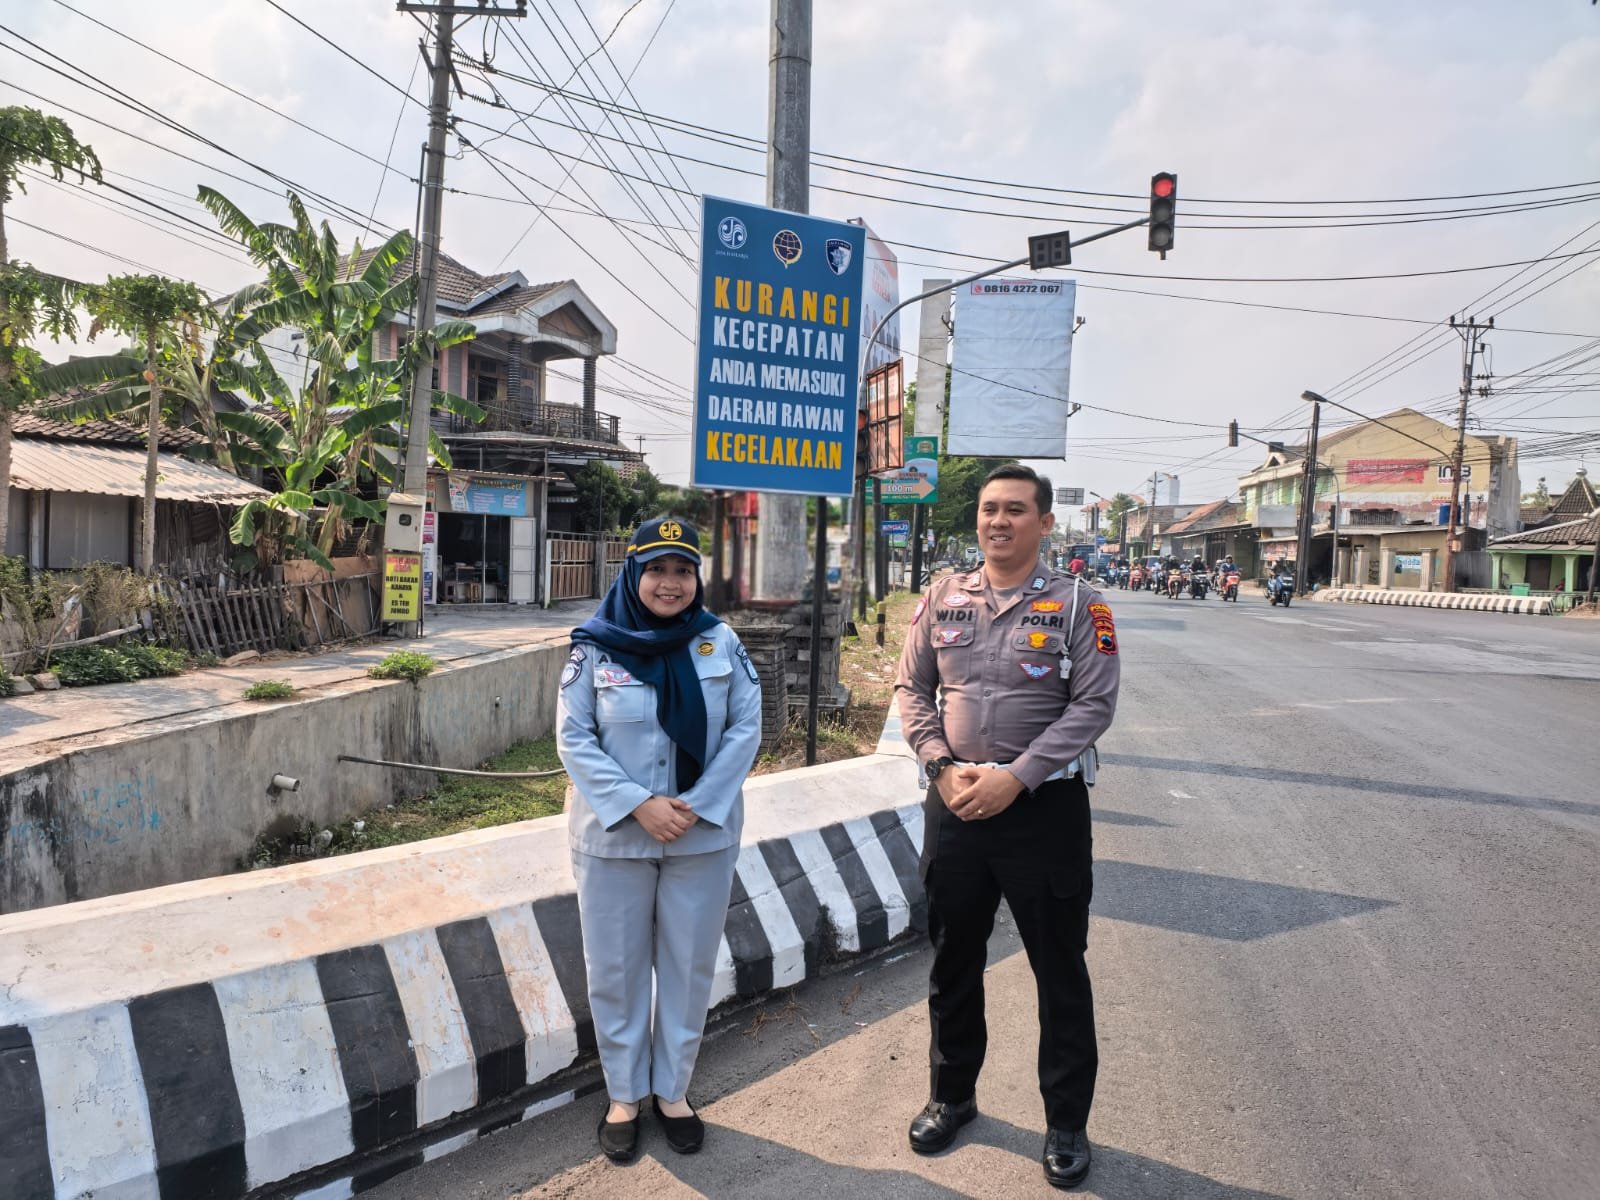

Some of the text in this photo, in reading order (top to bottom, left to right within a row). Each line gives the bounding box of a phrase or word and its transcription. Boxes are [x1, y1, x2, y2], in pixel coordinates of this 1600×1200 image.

[714, 276, 849, 328] KURANGI
[984, 285, 1060, 293] 0816 4272 067
[713, 316, 844, 362] KECEPATAN
[710, 358, 845, 397] ANDA MEMASUKI
[708, 395, 844, 433] DAERAH RAWAN
[706, 431, 842, 470] KECELAKAAN
[936, 609, 972, 623] WIDI
[1020, 615, 1064, 629] POLRI
